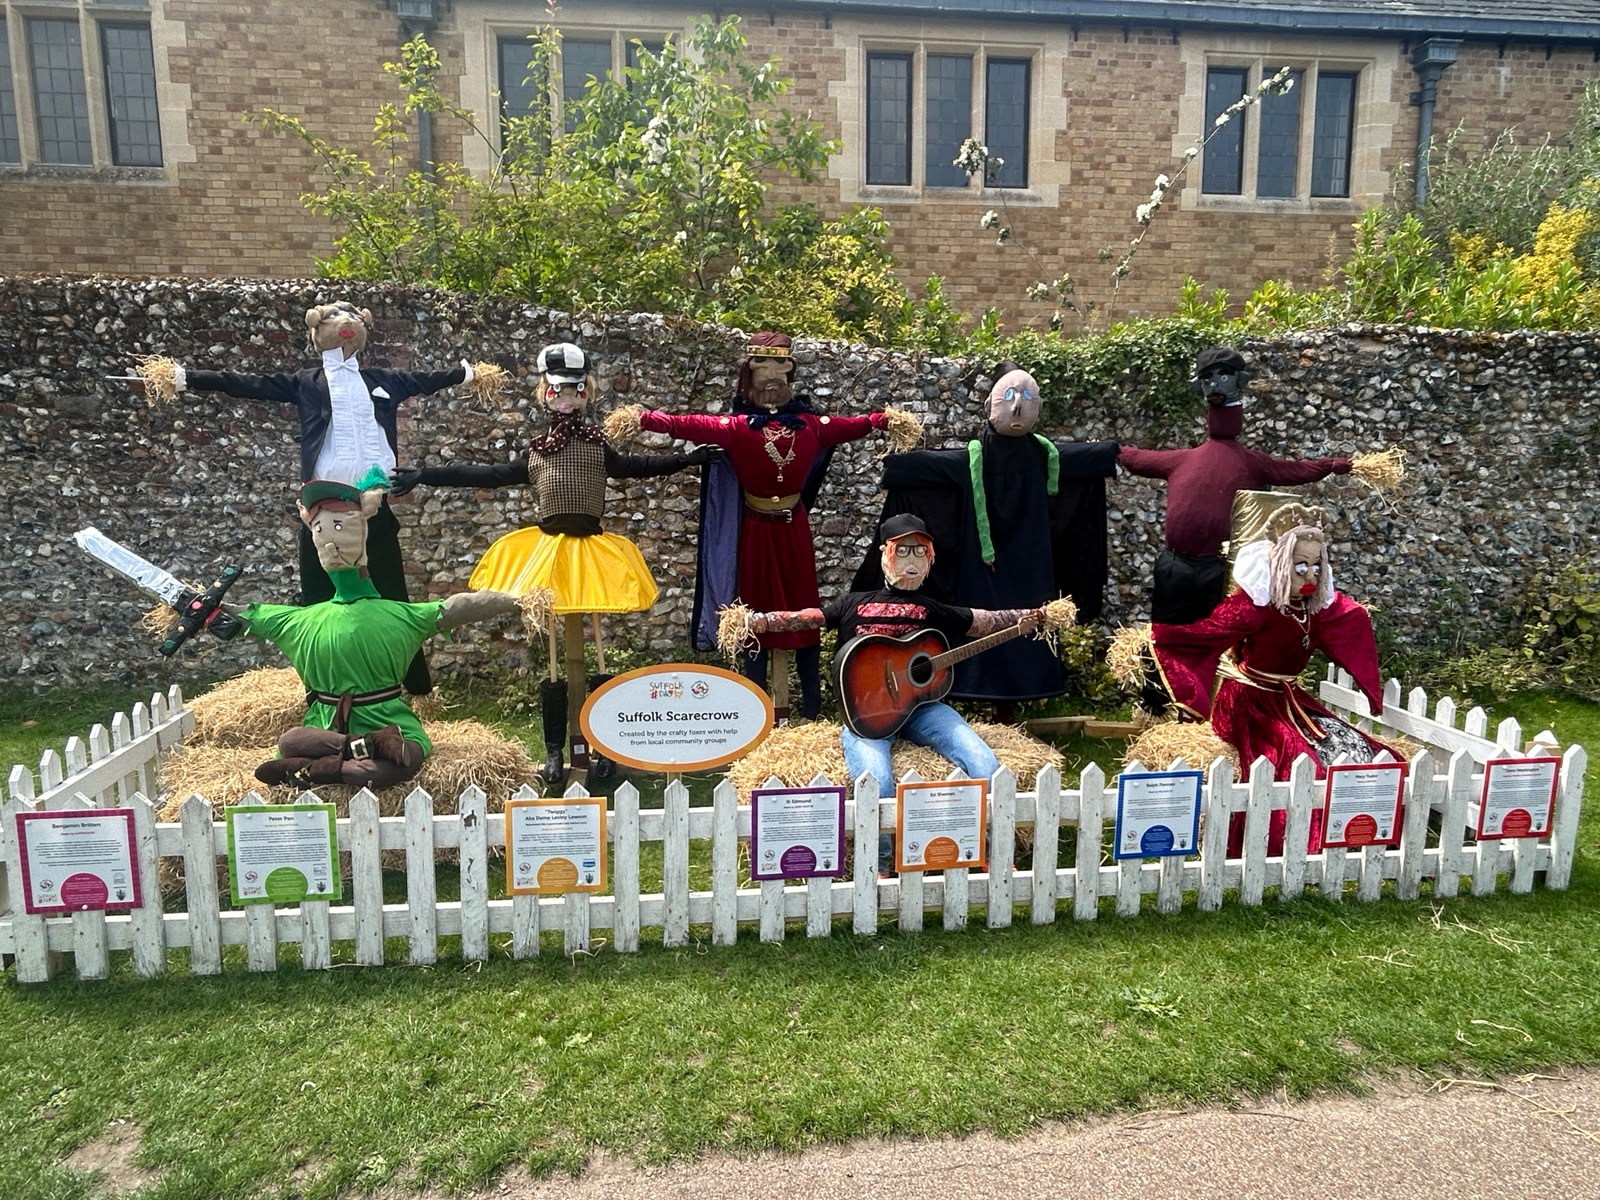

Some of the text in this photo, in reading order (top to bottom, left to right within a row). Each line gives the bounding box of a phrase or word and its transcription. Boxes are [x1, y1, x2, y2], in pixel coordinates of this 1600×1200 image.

[649, 681, 684, 691] SUFFOLK
[617, 710, 739, 723] Suffolk Scarecrows
[646, 730, 655, 738] by
[669, 729, 687, 737] crafty
[723, 728, 738, 736] help
[665, 738, 702, 746] community
[704, 738, 727, 746] groups
